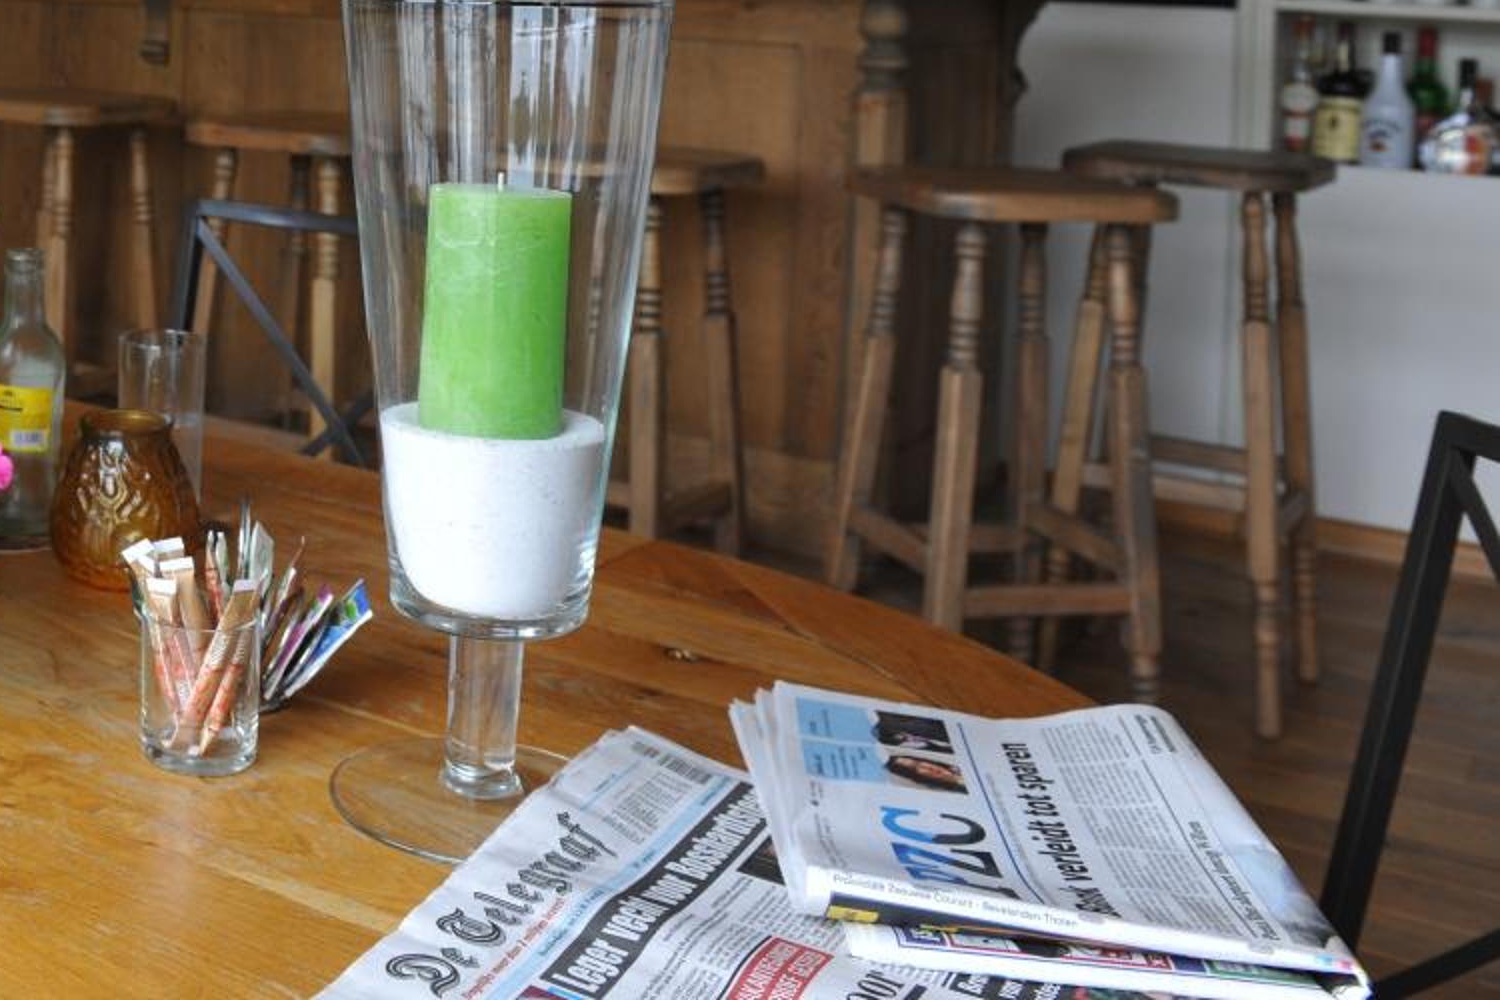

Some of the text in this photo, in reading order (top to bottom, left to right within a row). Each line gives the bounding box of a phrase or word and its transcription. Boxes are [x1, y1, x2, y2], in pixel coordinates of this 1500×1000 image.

[1000, 742, 1055, 791] sparen
[1016, 794, 1060, 817] tot
[1028, 820, 1093, 882] verleidt
[385, 947, 482, 999] De
[435, 810, 618, 947] Telegraaf
[551, 936, 629, 993] Leger
